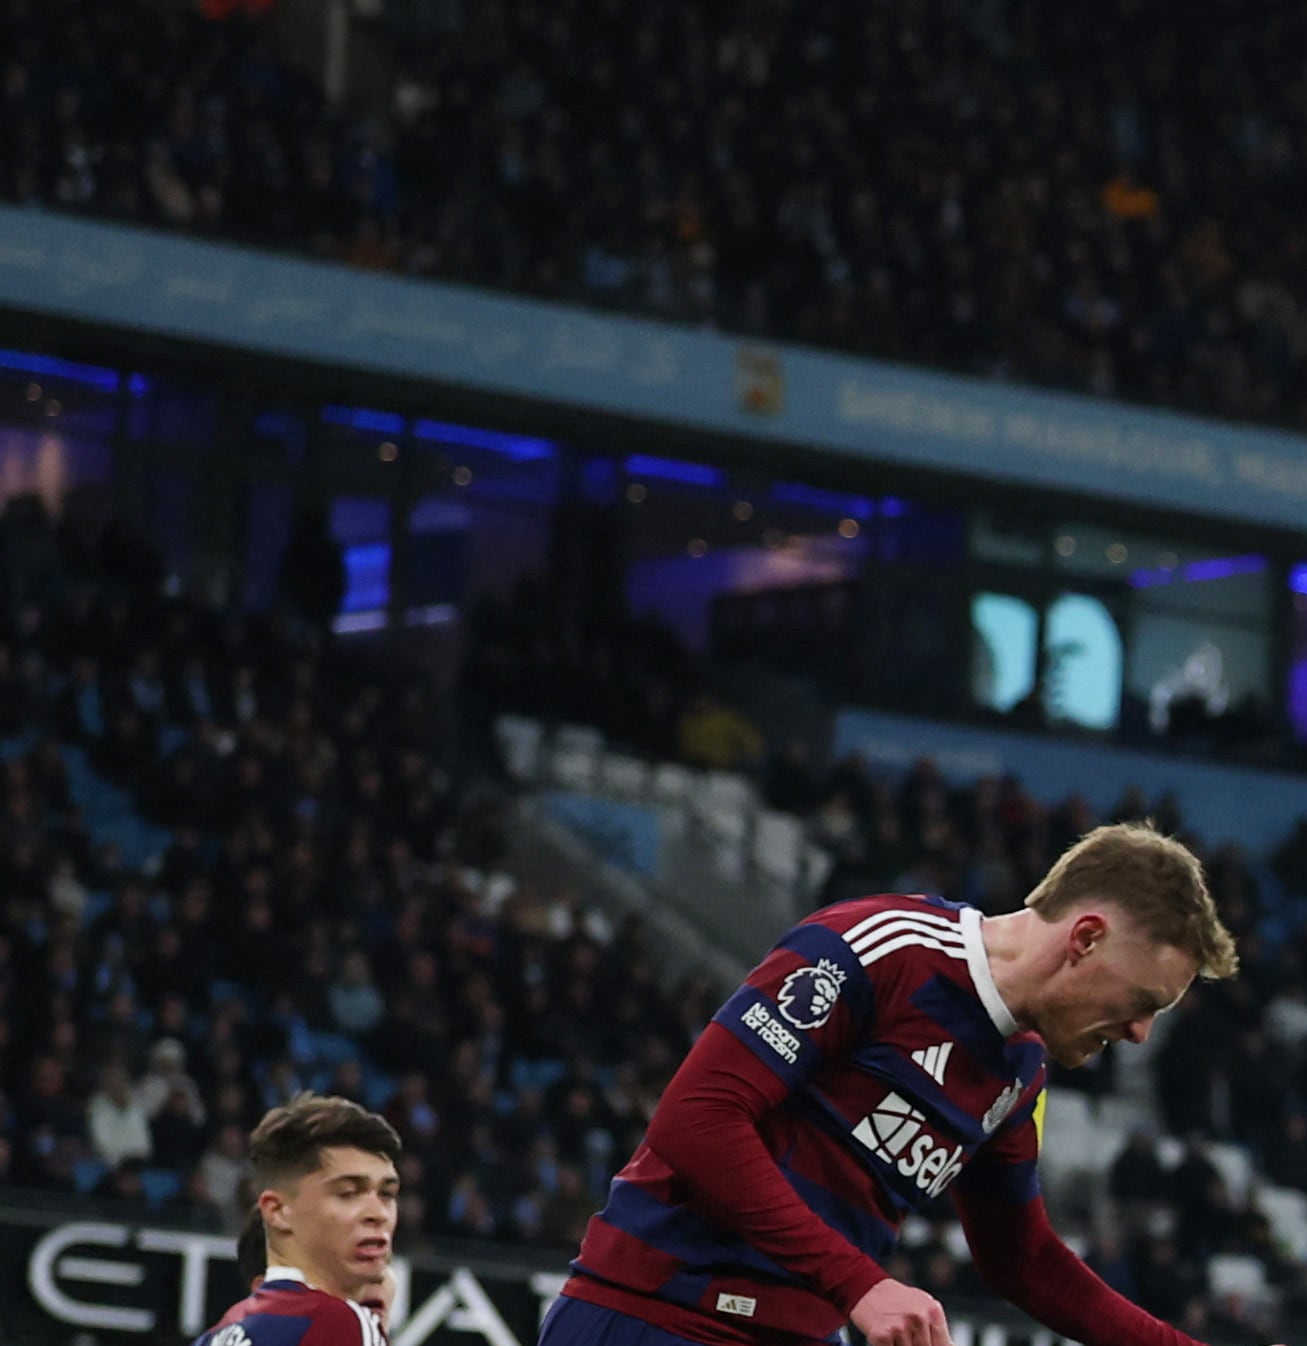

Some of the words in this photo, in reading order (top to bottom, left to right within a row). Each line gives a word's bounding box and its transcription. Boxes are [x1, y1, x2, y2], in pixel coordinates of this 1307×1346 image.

[747, 1002, 770, 1023] No
[766, 1018, 801, 1052] room
[757, 1026, 798, 1065] racism
[897, 1134, 963, 1199] sela
